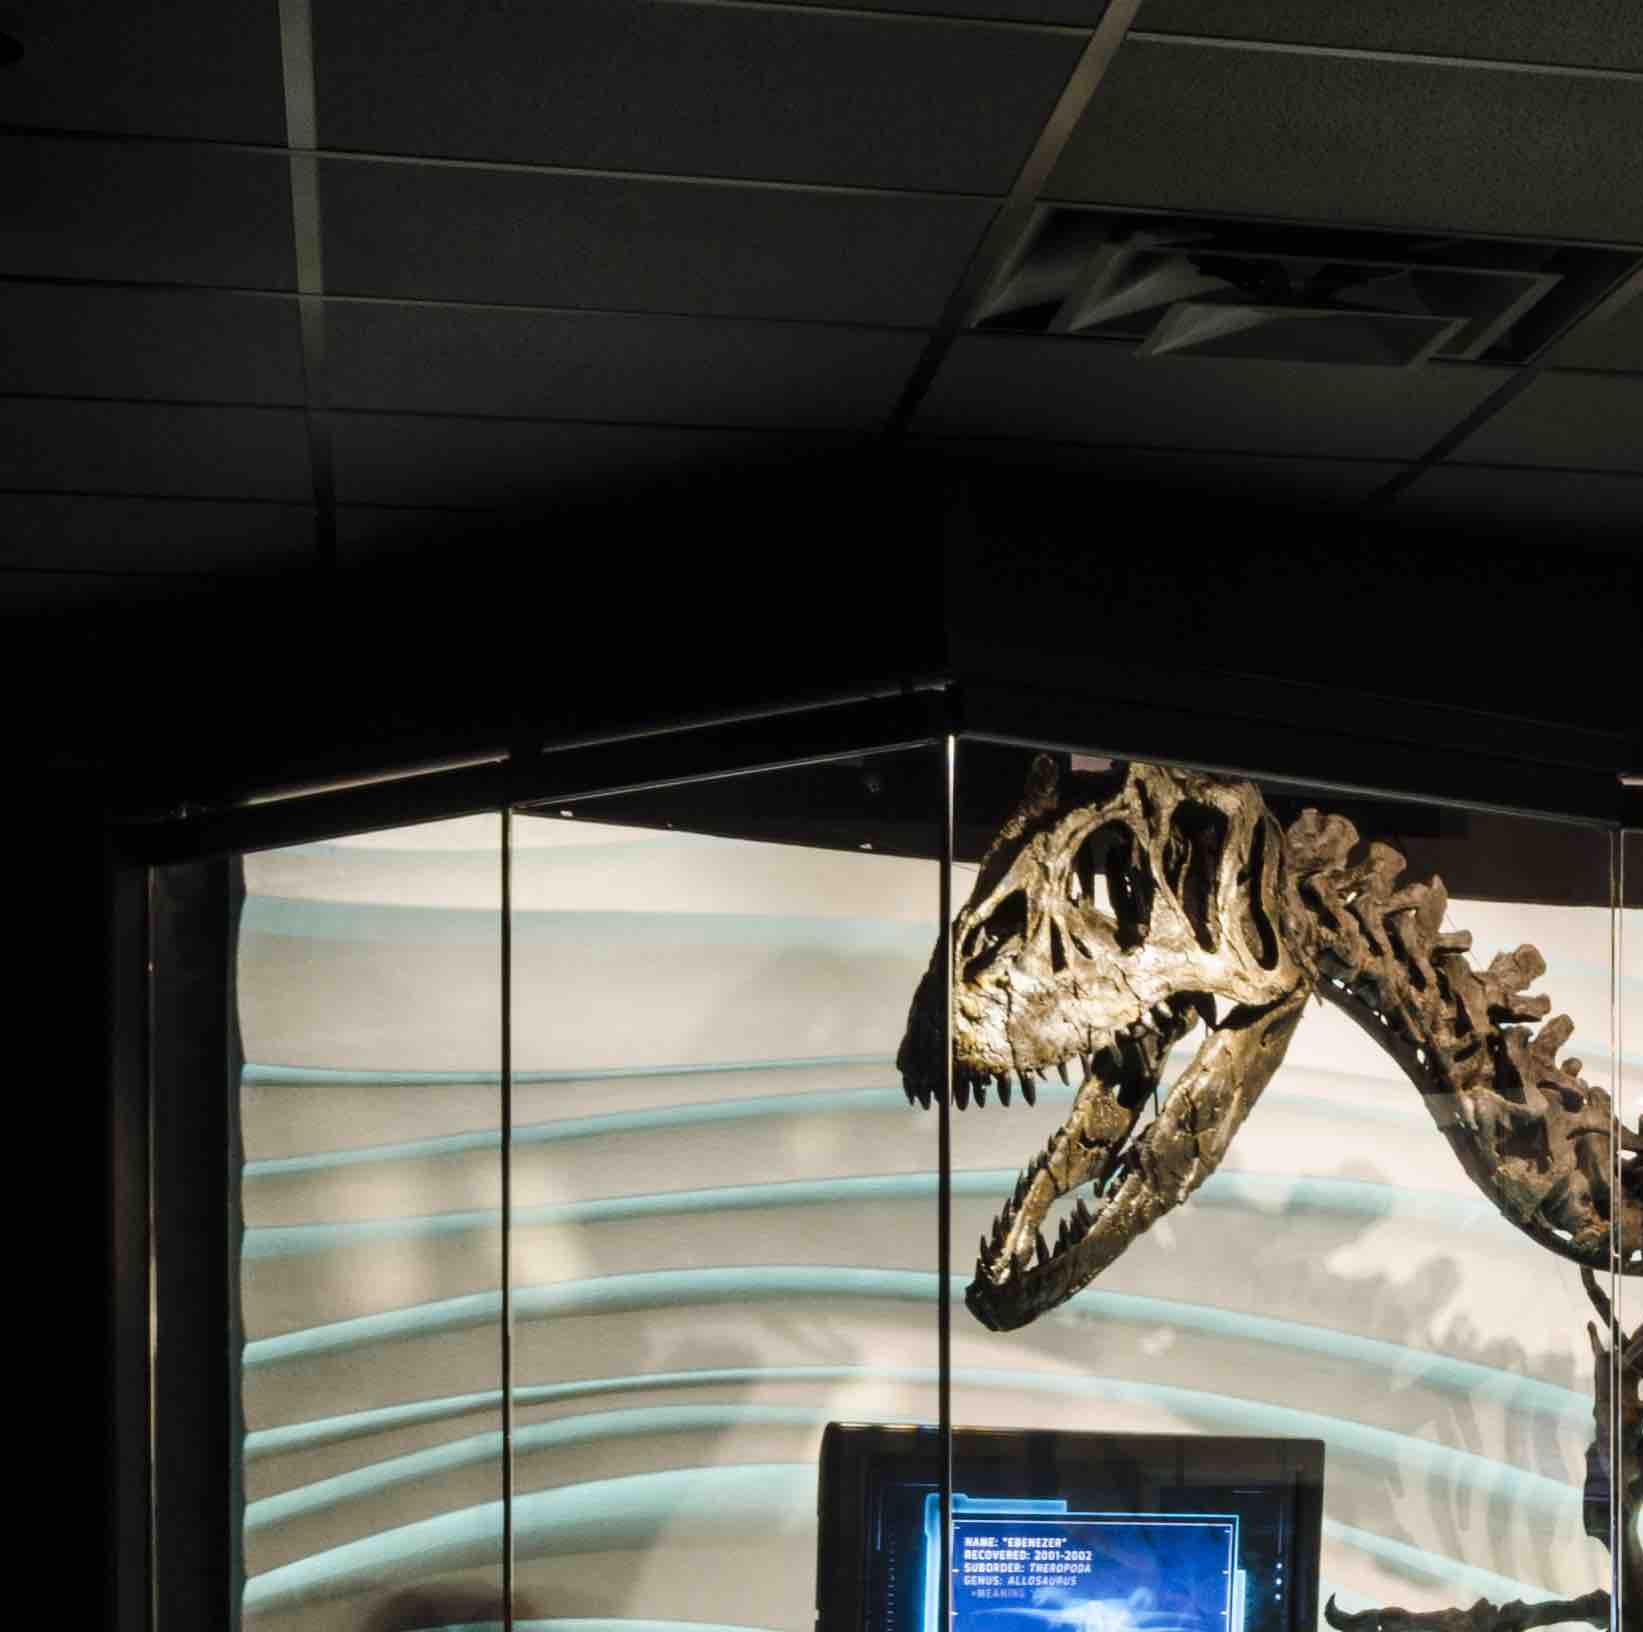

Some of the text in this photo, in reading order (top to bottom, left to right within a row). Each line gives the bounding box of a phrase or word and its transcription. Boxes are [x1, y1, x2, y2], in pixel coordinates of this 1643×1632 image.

[964, 1537, 998, 1547] NAME:
[964, 1549, 1092, 1561] RECOVERED: 2001-2002
[964, 1562, 1092, 1574] SUBORDER: THEROPODA
[964, 1575, 1077, 1586] GENUS: ALLOSAURUS
